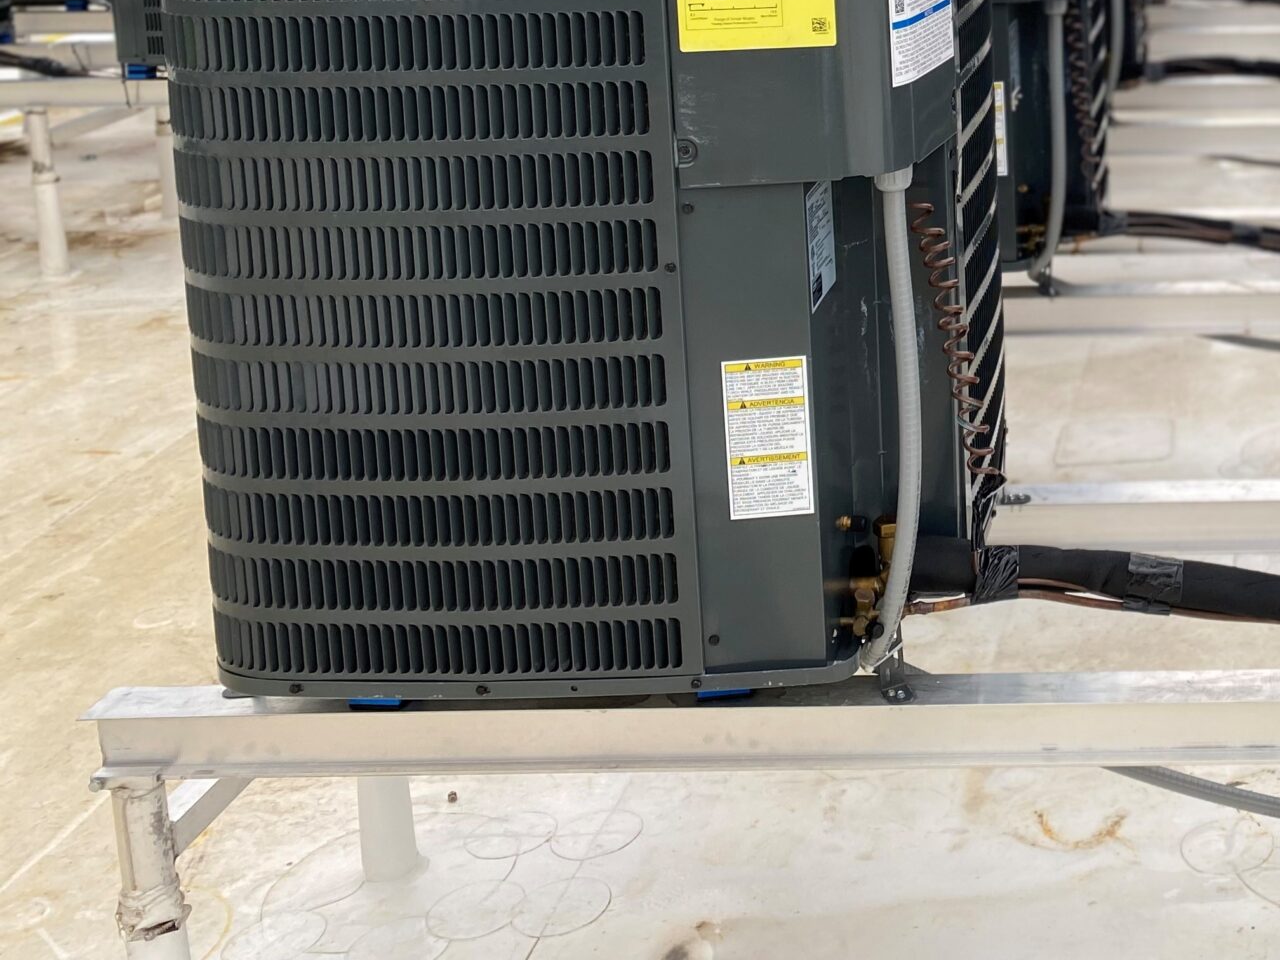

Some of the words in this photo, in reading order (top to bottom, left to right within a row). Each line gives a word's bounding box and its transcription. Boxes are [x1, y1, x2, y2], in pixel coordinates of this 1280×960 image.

[754, 361, 786, 369] WARNING
[749, 398, 795, 407] ADVERTENCIA
[747, 454, 801, 464] AVERTISSEMENT
